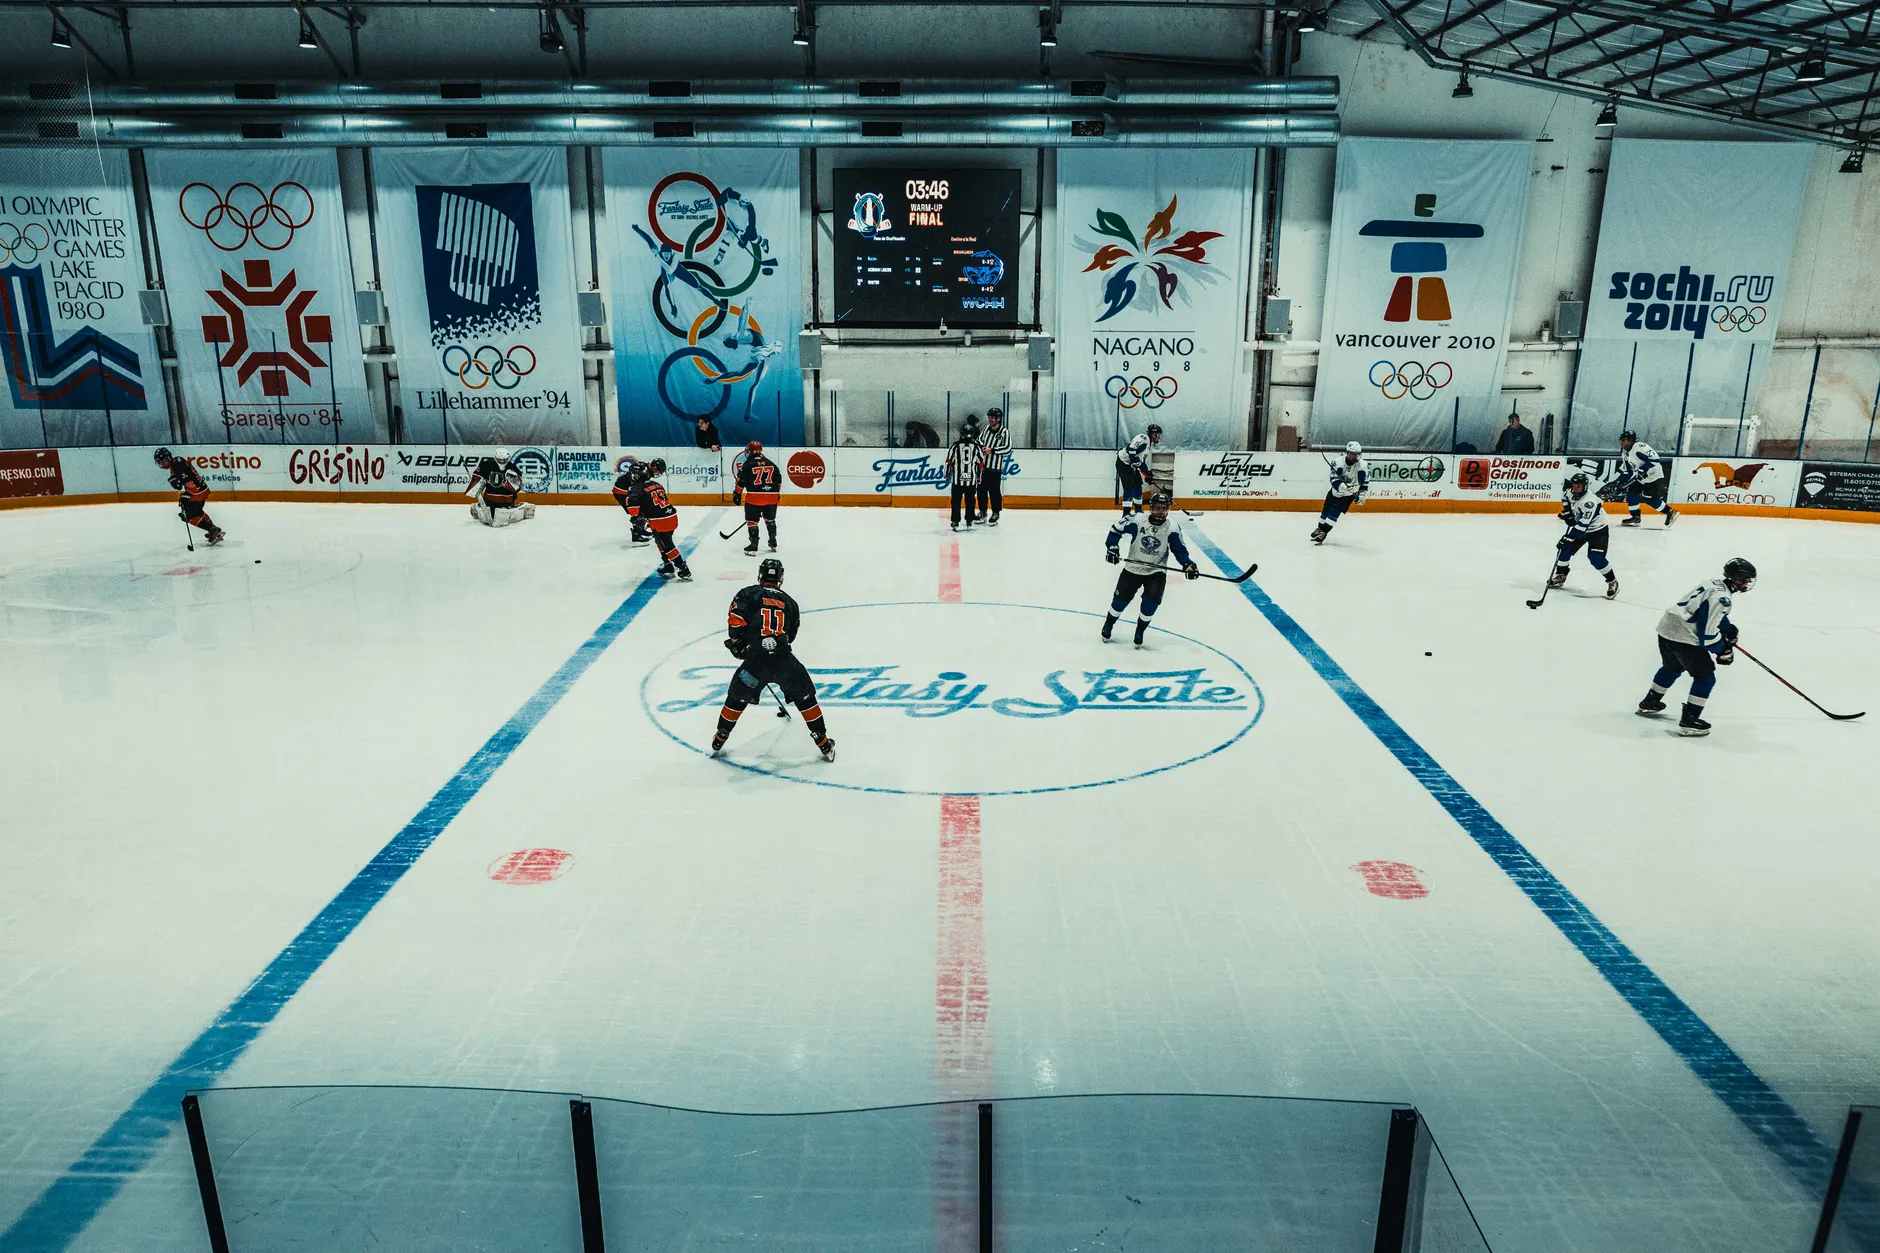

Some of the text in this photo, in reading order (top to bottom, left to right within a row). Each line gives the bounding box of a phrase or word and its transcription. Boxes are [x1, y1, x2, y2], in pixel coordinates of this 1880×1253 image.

[906, 180, 949, 200] 03:46
[12, 196, 102, 215] OLYMPIC
[658, 197, 714, 216] Fantasy Skate
[47, 218, 126, 237] WINTER
[909, 212, 944, 226] FINAL
[54, 240, 125, 258] GAMES
[50, 260, 97, 278] LAKE
[54, 281, 124, 299] PLACID
[1609, 265, 1774, 303] sochi.ru
[57, 301, 105, 320] 1980
[1624, 302, 1710, 339] 2014
[1093, 337, 1194, 356] NAGANO
[1335, 333, 1495, 349] vancouver 2010
[416, 390, 541, 410] Lillehammer
[220, 409, 310, 430] Sarajevo
[187, 451, 262, 469] restino
[558, 452, 606, 462] ACADEMIA
[1491, 457, 1560, 470] Desimone
[0, 467, 56, 480] RESKO.COM
[558, 462, 601, 471] DE ARTES
[752, 466, 775, 485] 77
[787, 465, 824, 474] CRESKO
[1490, 469, 1528, 480] Grillo
[1490, 481, 1552, 491] Propiedades
[760, 608, 786, 637] 11
[991, 668, 1247, 719] Skate
